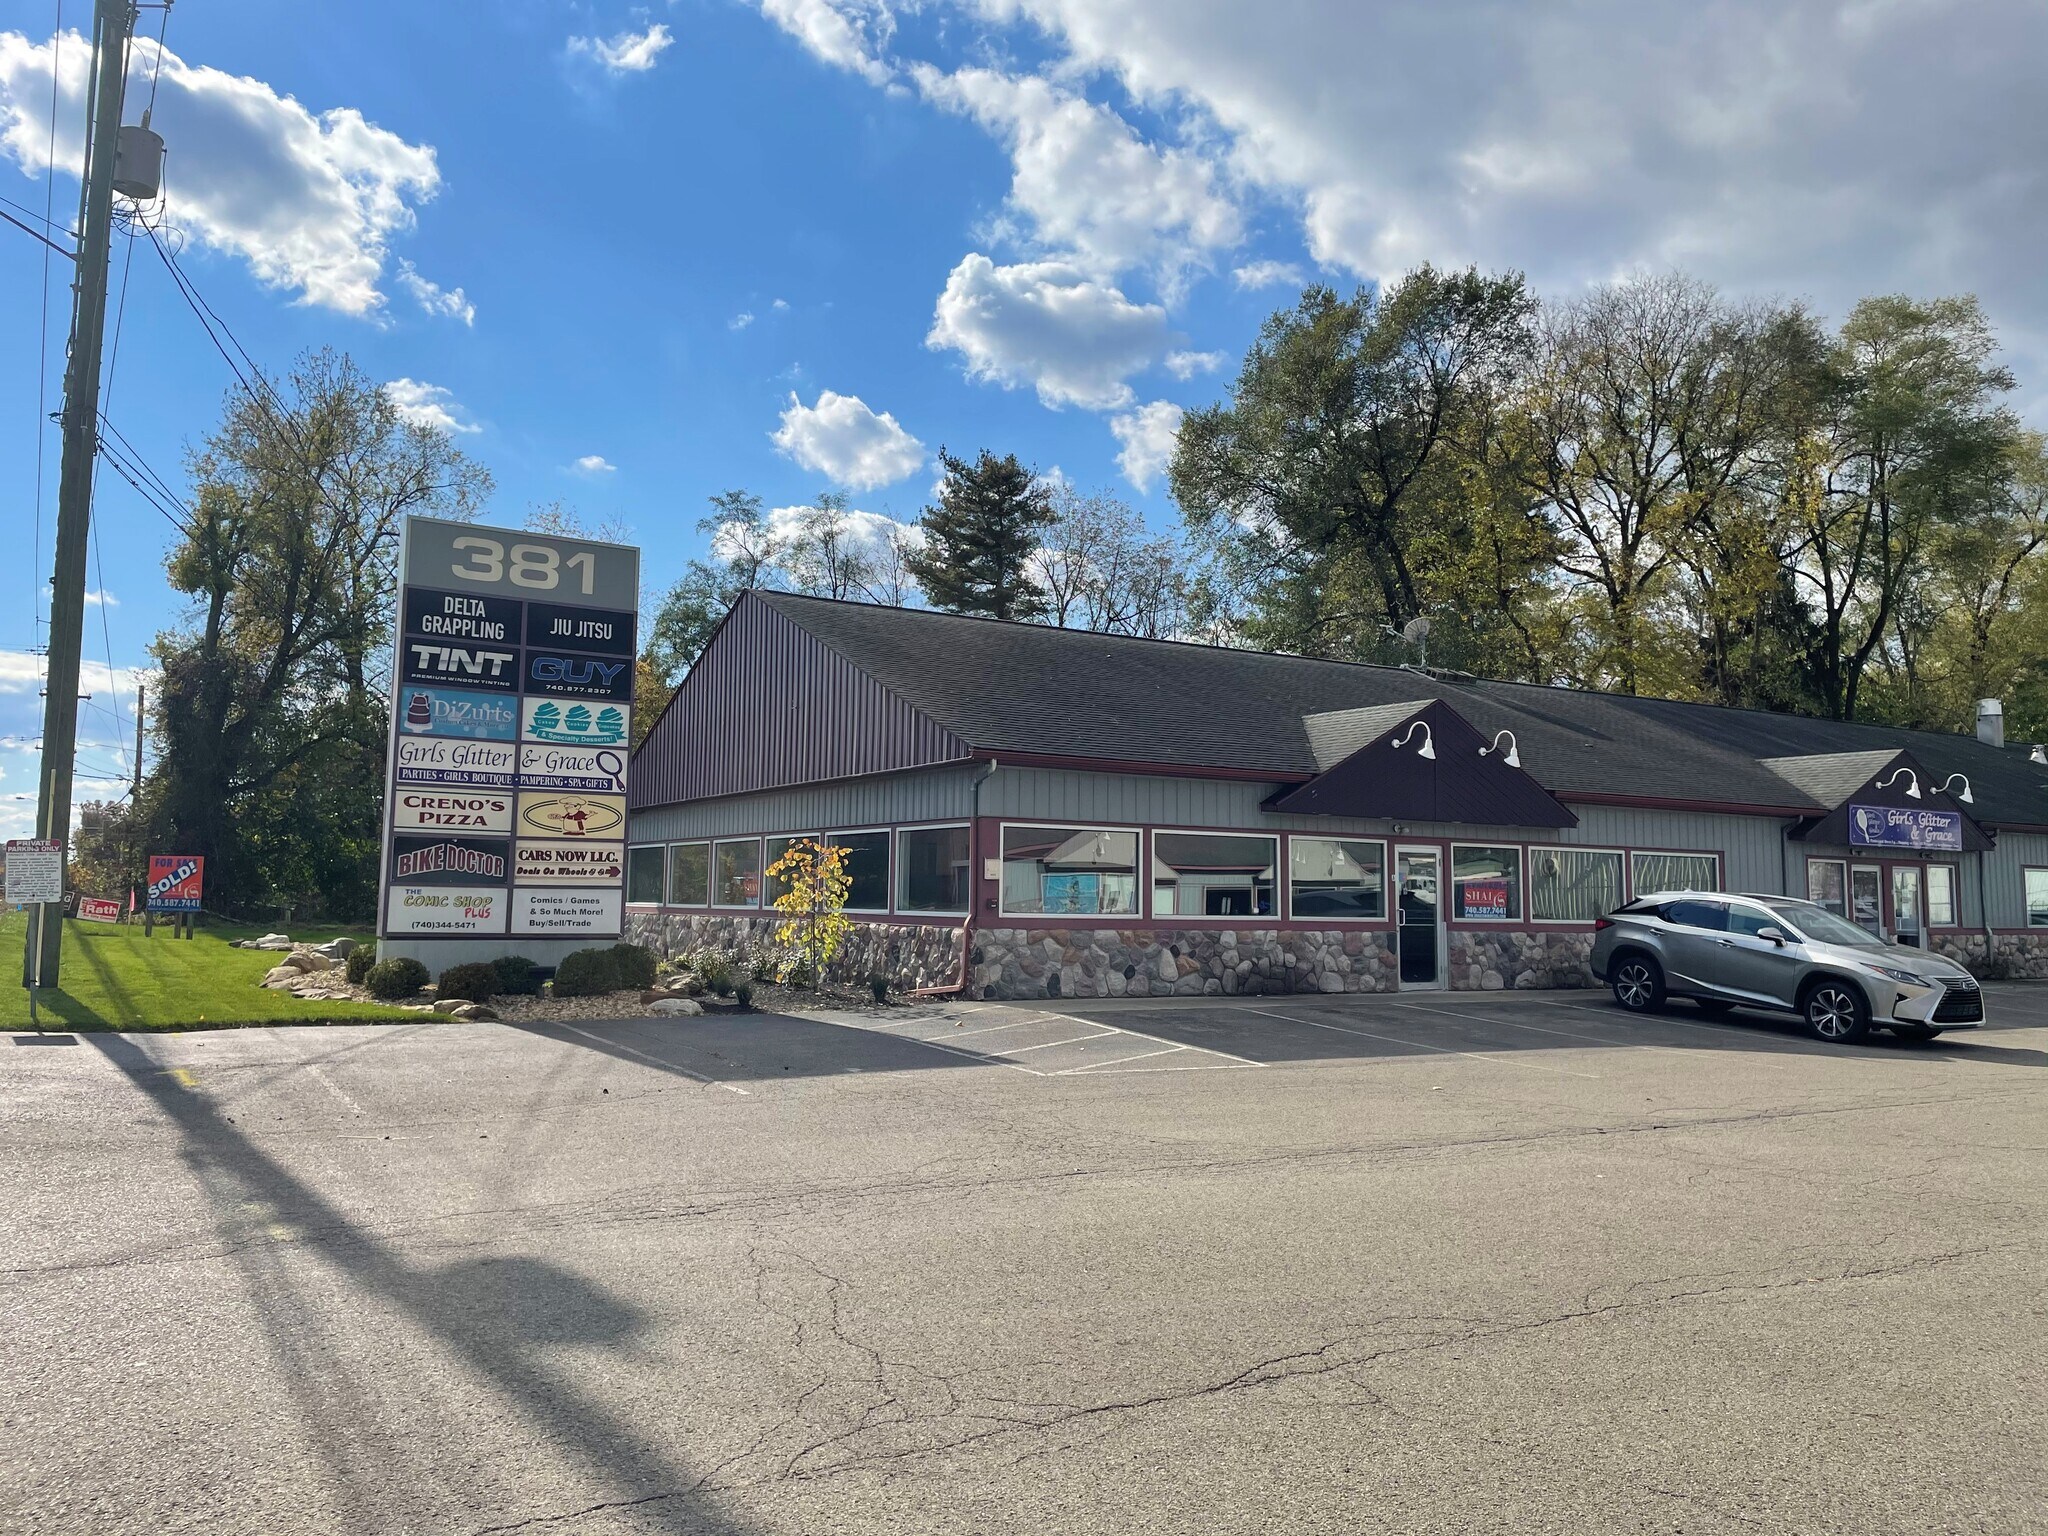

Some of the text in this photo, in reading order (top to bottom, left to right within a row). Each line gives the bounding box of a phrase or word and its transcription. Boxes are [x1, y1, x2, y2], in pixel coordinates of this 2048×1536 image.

[451, 536, 595, 595] 381
[444, 596, 486, 618] DELTA
[422, 615, 505, 640] GRAPPLING
[549, 618, 613, 640] JIU JITSU
[411, 644, 626, 686] TINT GUY
[411, 673, 511, 687] PREMIUM WINDOW TINTING
[545, 684, 612, 695] 740.877.2307
[434, 699, 513, 723] DiZurts
[548, 732, 580, 743] Specialty
[400, 741, 594, 774] Girls Glitter & Grace
[402, 768, 608, 789] PARTIES GIRLS BOUTIQUE PAMPERING SPA GIFTS
[403, 795, 505, 812] CRENO'S
[419, 812, 488, 826] PIZZA
[1887, 810, 1914, 826] Girls
[1918, 812, 1951, 828] Glitter
[1910, 825, 1920, 840] &
[155, 858, 173, 867] FOR
[397, 843, 504, 877] BIKE DOCTOR
[518, 849, 619, 863] CARS NOW LLC.
[517, 866, 588, 876] Deals On Wheels
[148, 861, 197, 899] SOLD!
[403, 895, 493, 908] COMIC SHOP
[530, 896, 563, 904] Comics
[1465, 890, 1492, 901] SHAI
[85, 904, 117, 915] Rath
[464, 907, 491, 919] PLUS
[579, 908, 604, 916] More!
[411, 921, 476, 930] (740)344-5471
[529, 919, 592, 928] Buy/Sell/Trade
